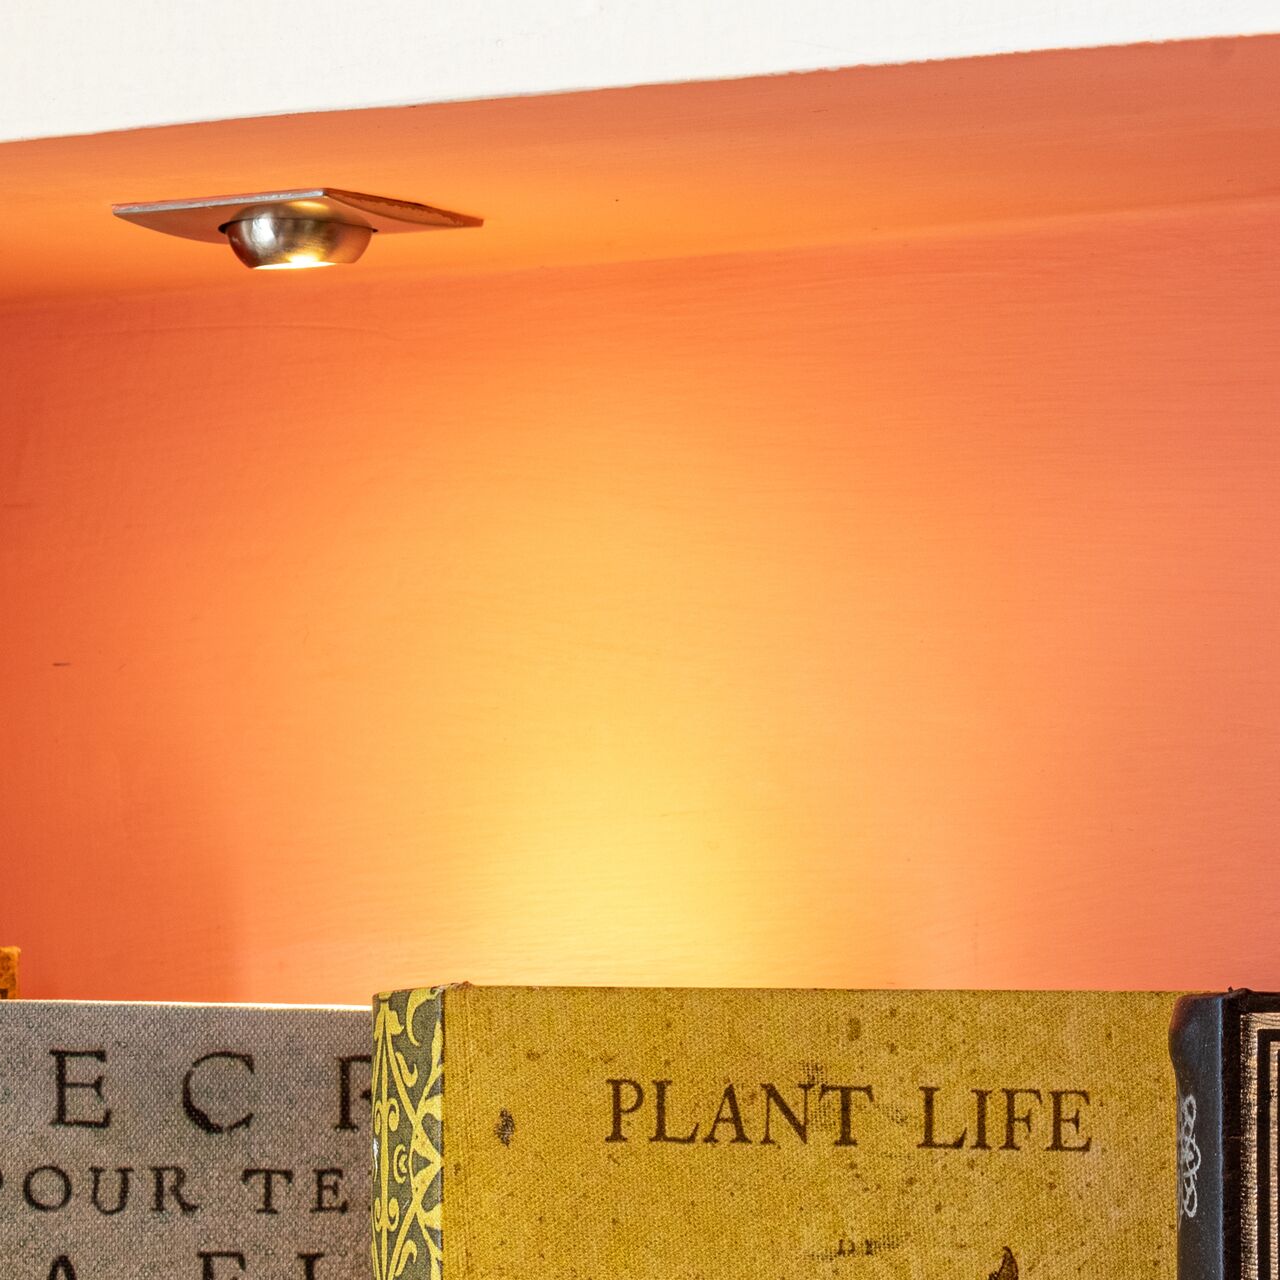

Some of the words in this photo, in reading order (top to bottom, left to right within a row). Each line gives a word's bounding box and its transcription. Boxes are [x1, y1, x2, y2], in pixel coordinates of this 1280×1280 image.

[605, 1079, 875, 1147] PLANT
[916, 1086, 1093, 1154] LIFE
[242, 1168, 372, 1215] TE
